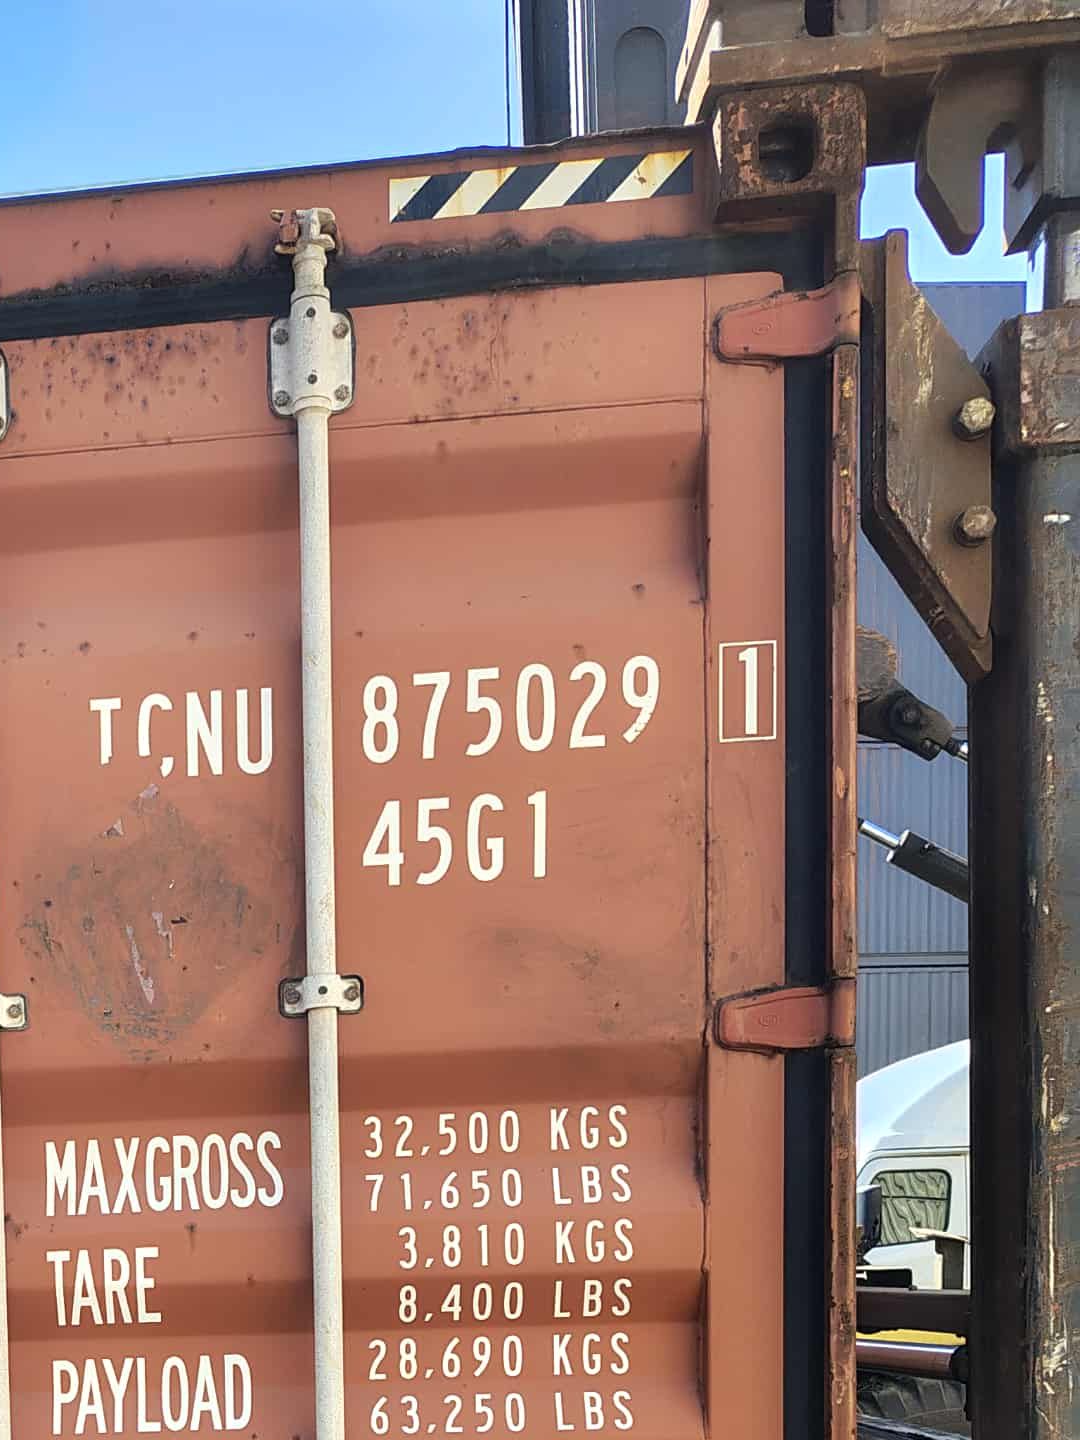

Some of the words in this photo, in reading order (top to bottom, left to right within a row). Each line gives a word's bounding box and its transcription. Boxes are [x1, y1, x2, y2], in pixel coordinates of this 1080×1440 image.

[361, 655, 660, 764] 875029
[738, 647, 758, 735] 1
[362, 790, 547, 886] 45G1
[45, 1131, 284, 1217] MAXGROSS
[364, 1110, 520, 1158] 32,500
[550, 1105, 629, 1151] KGS
[365, 1168, 522, 1212] 71,650
[552, 1163, 632, 1205] LBS
[46, 1246, 162, 1326] TARE
[398, 1222, 525, 1270] 3,810
[555, 1218, 633, 1264] KGS
[398, 1282, 523, 1323] 8,400
[553, 1278, 632, 1318] LBS
[52, 1353, 252, 1435] PAYLOAD
[368, 1335, 523, 1380] 28,690
[553, 1332, 630, 1376] KGS
[370, 1392, 526, 1435] 63,250
[554, 1390, 634, 1431] LBS
